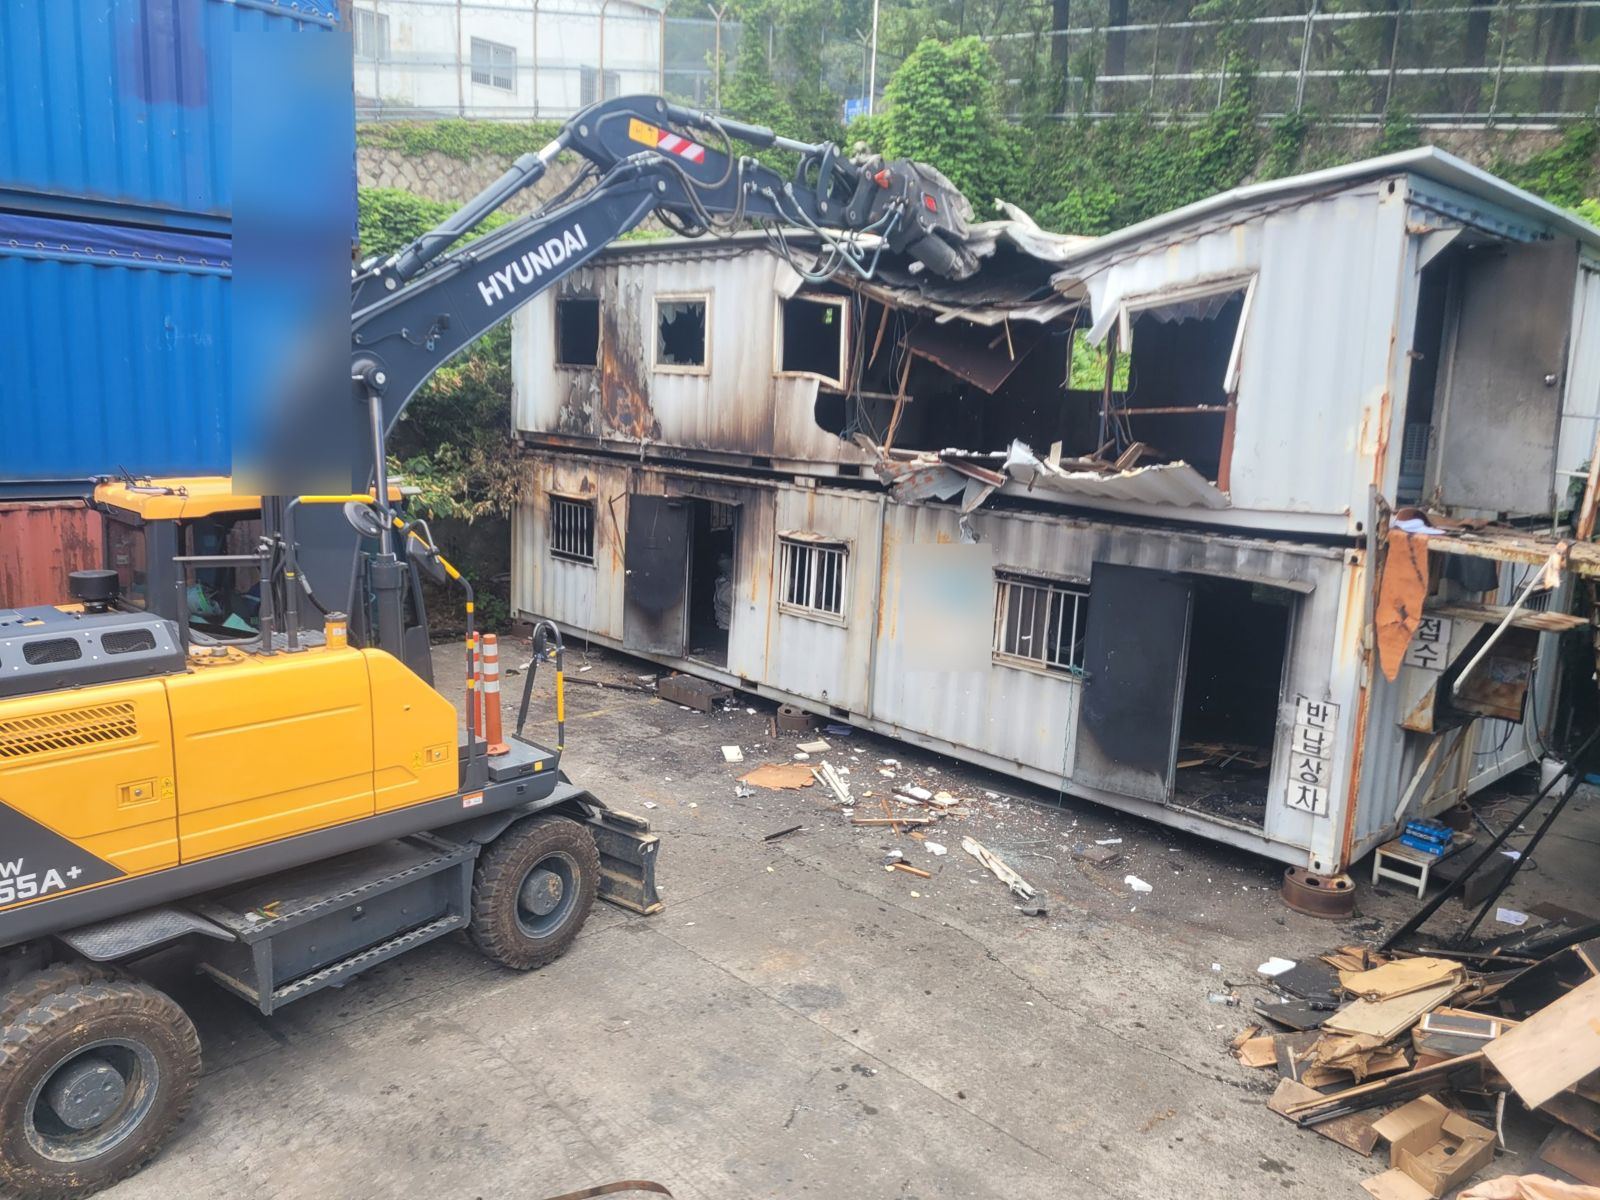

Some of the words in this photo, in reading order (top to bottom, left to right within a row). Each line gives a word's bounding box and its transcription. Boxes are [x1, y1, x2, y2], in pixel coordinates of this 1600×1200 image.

[477, 223, 588, 306] HYUNDAI
[1413, 618, 1442, 667] 접수
[1295, 702, 1328, 811] 반납상차
